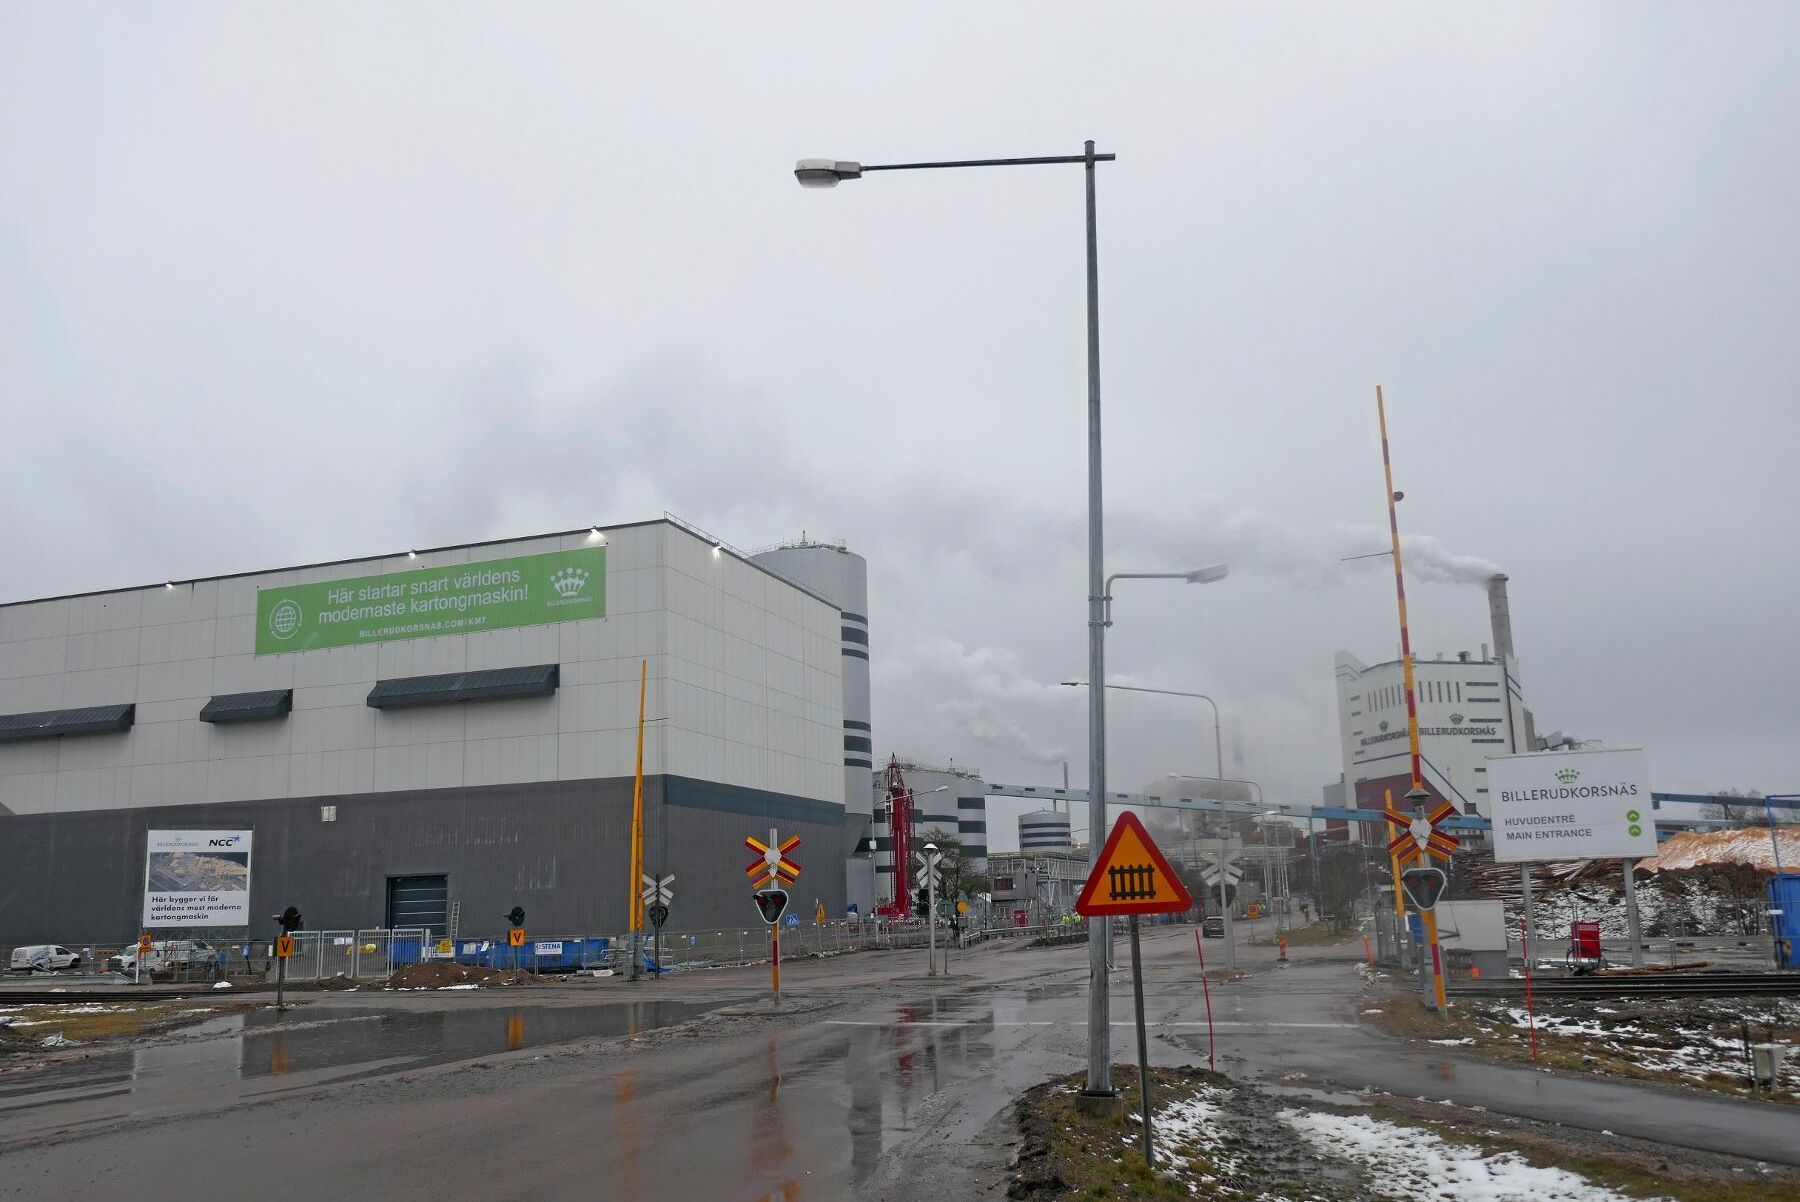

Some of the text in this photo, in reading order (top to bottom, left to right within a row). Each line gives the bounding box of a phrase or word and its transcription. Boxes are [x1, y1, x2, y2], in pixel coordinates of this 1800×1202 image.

[328, 569, 520, 605] Här startar snart världens
[319, 584, 528, 624] modernaste kartongmaskin!
[1419, 726, 1496, 736] BILLERUDKORSNÄS
[1501, 782, 1638, 802] BILLERUDKORSNÄS
[1505, 814, 1576, 826] HUVUDENTRÉ
[1506, 828, 1592, 840] MAIN ENTRANCE
[209, 839, 234, 847] NCC
[513, 932, 521, 943] V
[281, 940, 290, 953] V
